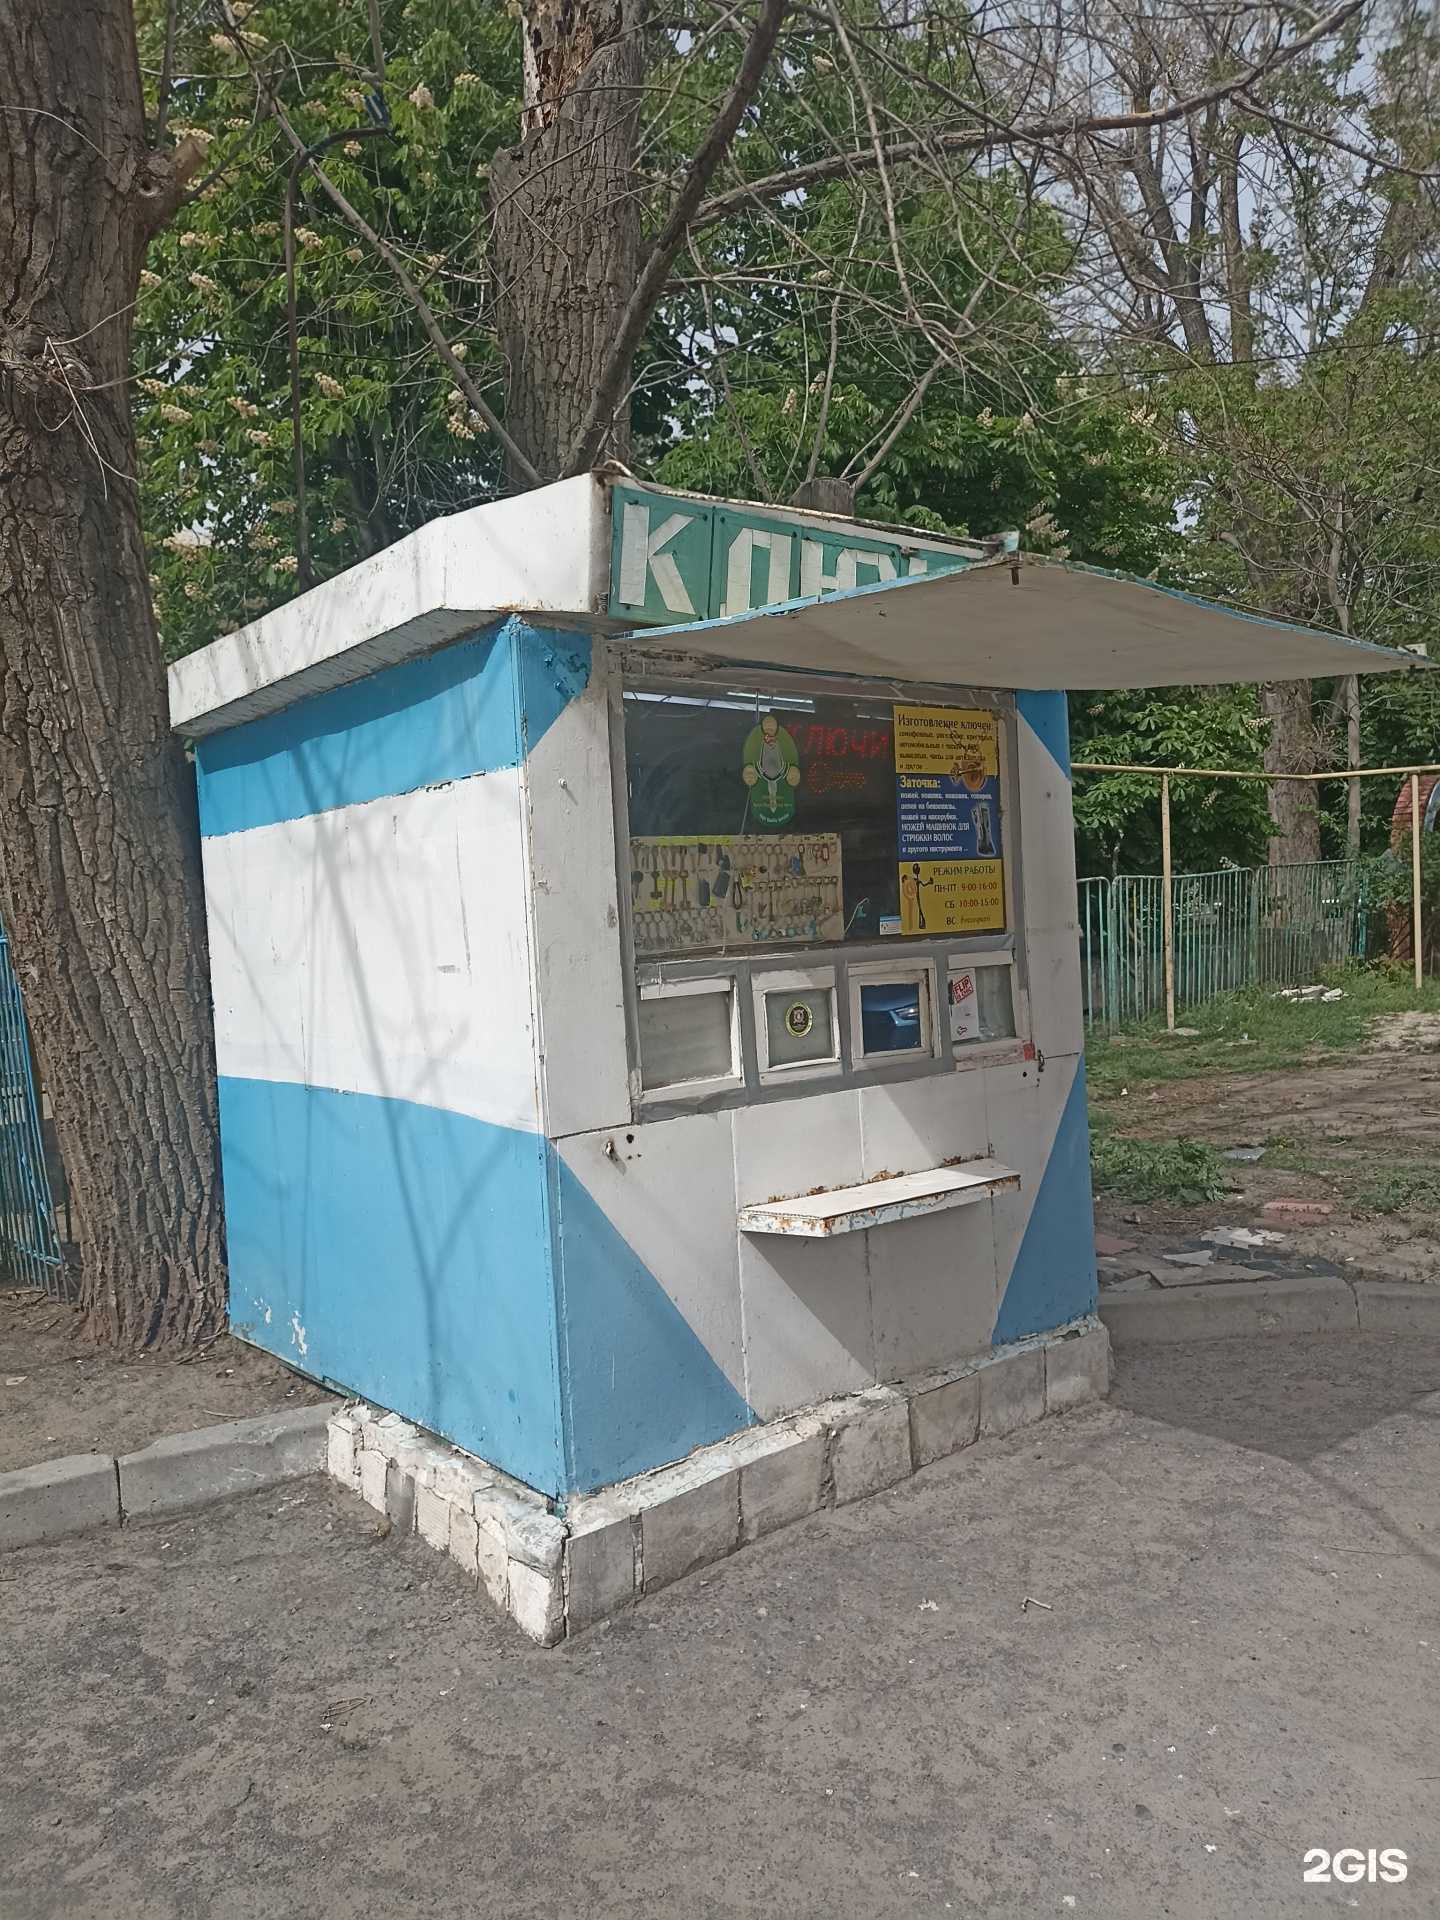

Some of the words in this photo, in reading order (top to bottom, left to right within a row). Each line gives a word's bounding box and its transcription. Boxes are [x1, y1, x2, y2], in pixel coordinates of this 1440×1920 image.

[619, 503, 928, 617] КЛЮ
[898, 714, 959, 729] Изготовление
[900, 775, 941, 788] Заточка:
[901, 822, 925, 831] НОЖЕЙ
[925, 823, 957, 831] МАШИНОК
[958, 822, 970, 831] ДЛЯ
[902, 833, 933, 842] СТРИЖКИ
[933, 833, 954, 842] ВОЛОС
[933, 866, 962, 876] РЕЖИМ
[964, 865, 996, 875] РАБОТЫ
[934, 883, 957, 893] ПН-ПТ
[944, 900, 955, 909] СБ
[946, 917, 957, 926] ВС
